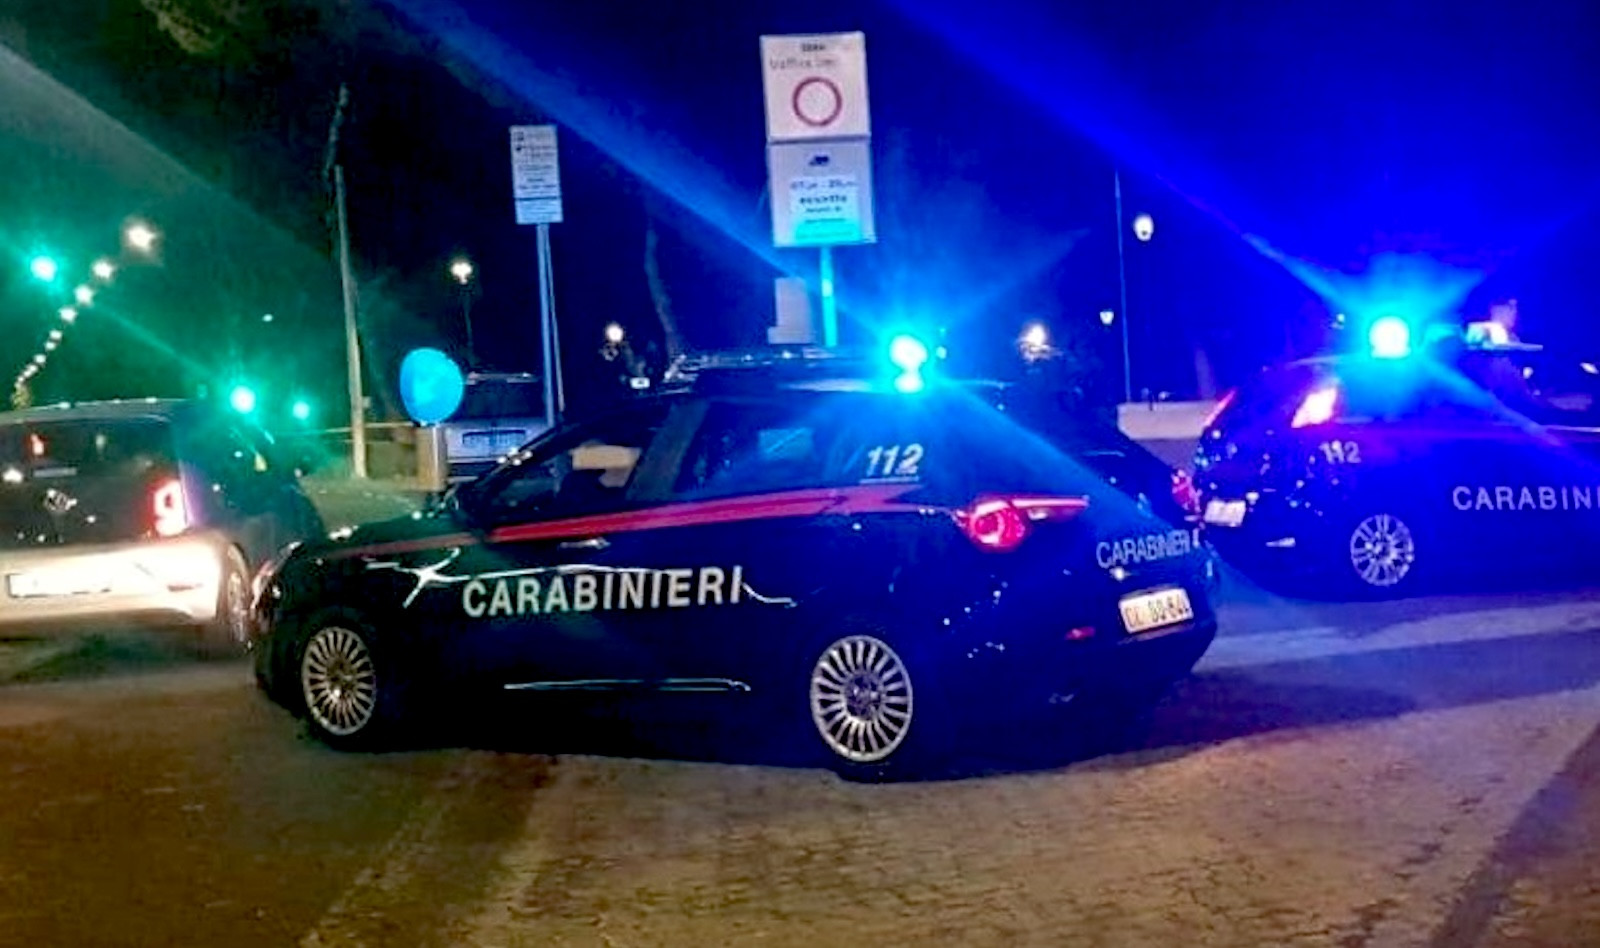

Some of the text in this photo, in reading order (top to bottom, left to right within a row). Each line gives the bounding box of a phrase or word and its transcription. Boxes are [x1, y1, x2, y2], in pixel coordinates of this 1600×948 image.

[865, 443, 924, 476] 112
[1319, 440, 1362, 464] 112
[1452, 486, 1600, 511] CARABIN
[462, 566, 742, 617] CARABINIERI
